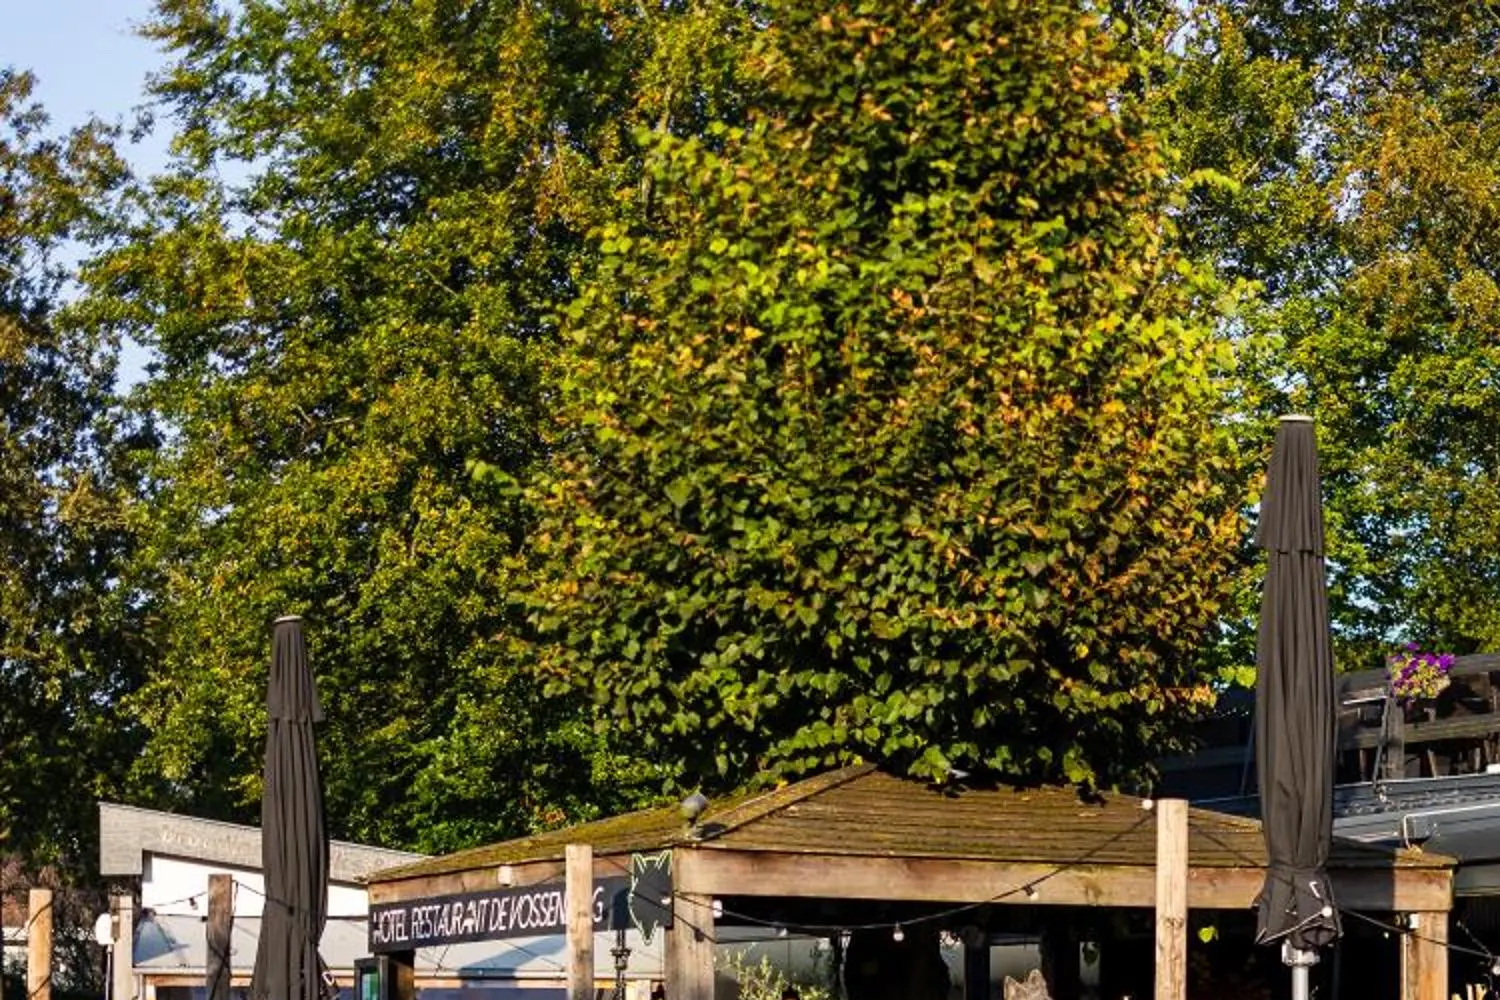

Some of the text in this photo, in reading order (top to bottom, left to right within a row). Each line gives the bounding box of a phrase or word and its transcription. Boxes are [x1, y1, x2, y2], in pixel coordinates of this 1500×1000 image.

[372, 910, 408, 944] HOTEL
[411, 897, 490, 941] RESTAURANT
[489, 896, 508, 932] DE
